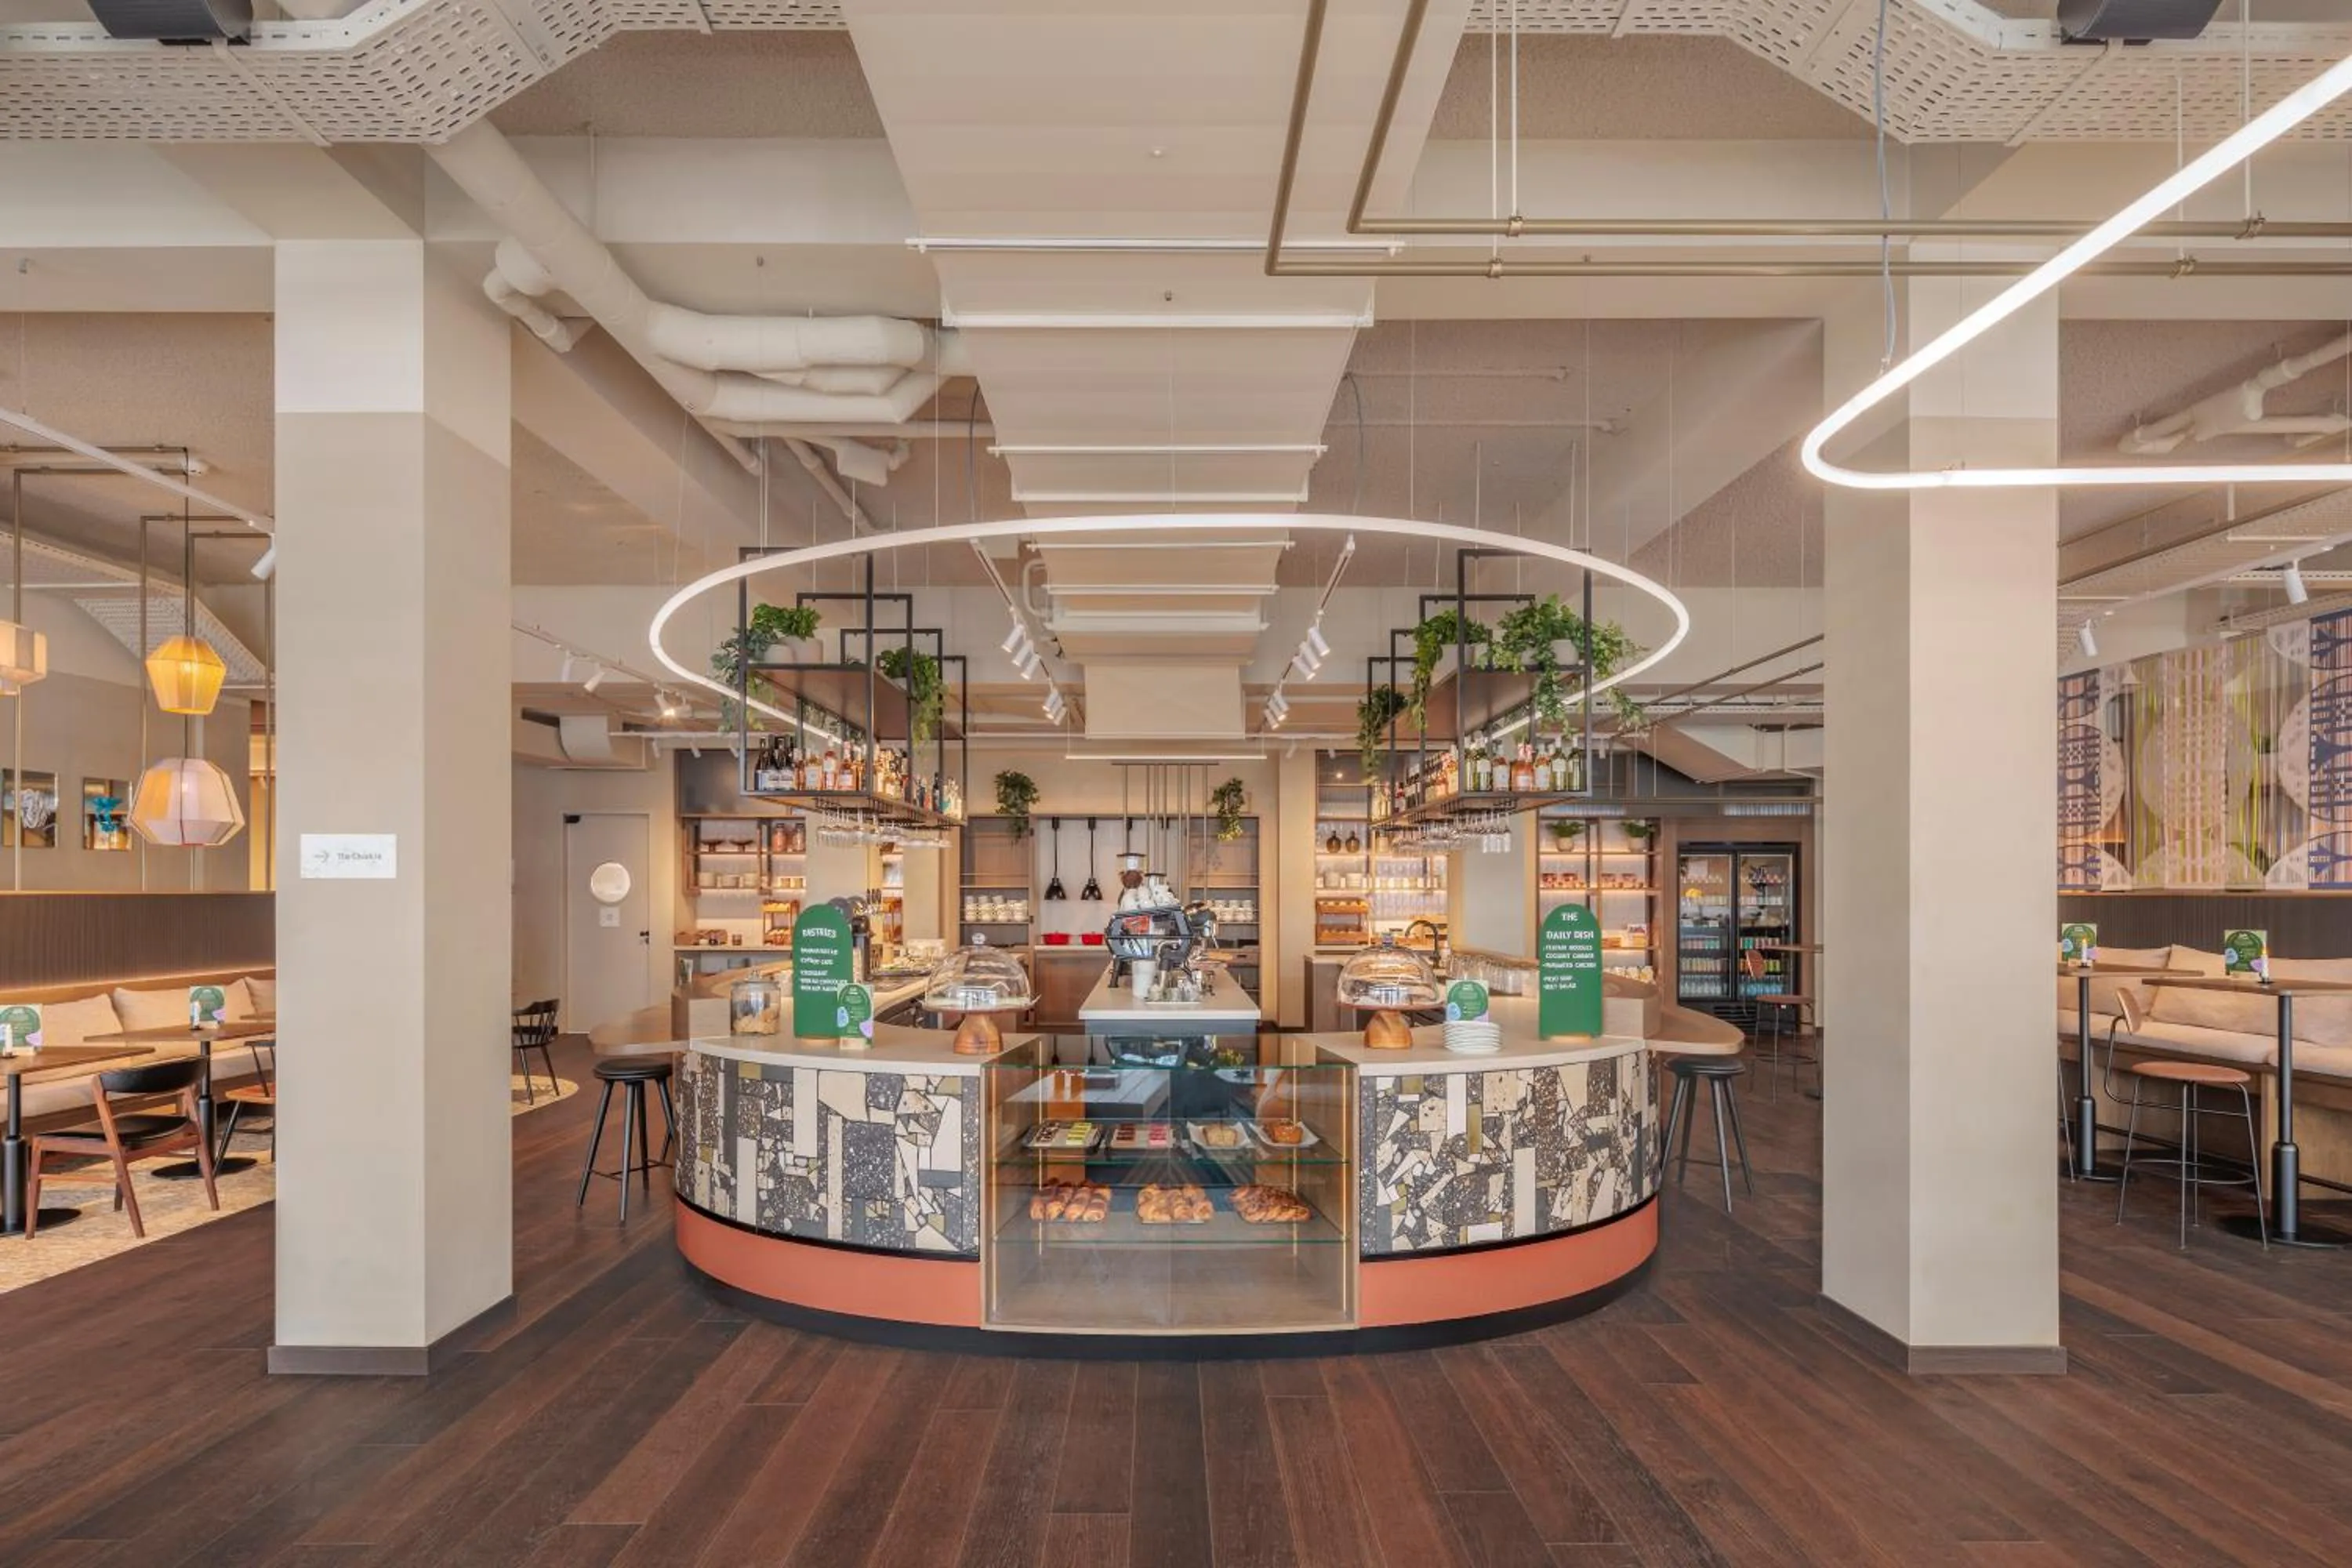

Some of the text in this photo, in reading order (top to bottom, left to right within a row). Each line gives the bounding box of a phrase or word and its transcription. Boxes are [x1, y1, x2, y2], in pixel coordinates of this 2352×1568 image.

[1562, 912, 1578, 921] THE
[1546, 931, 1594, 940] DAILY DISH
